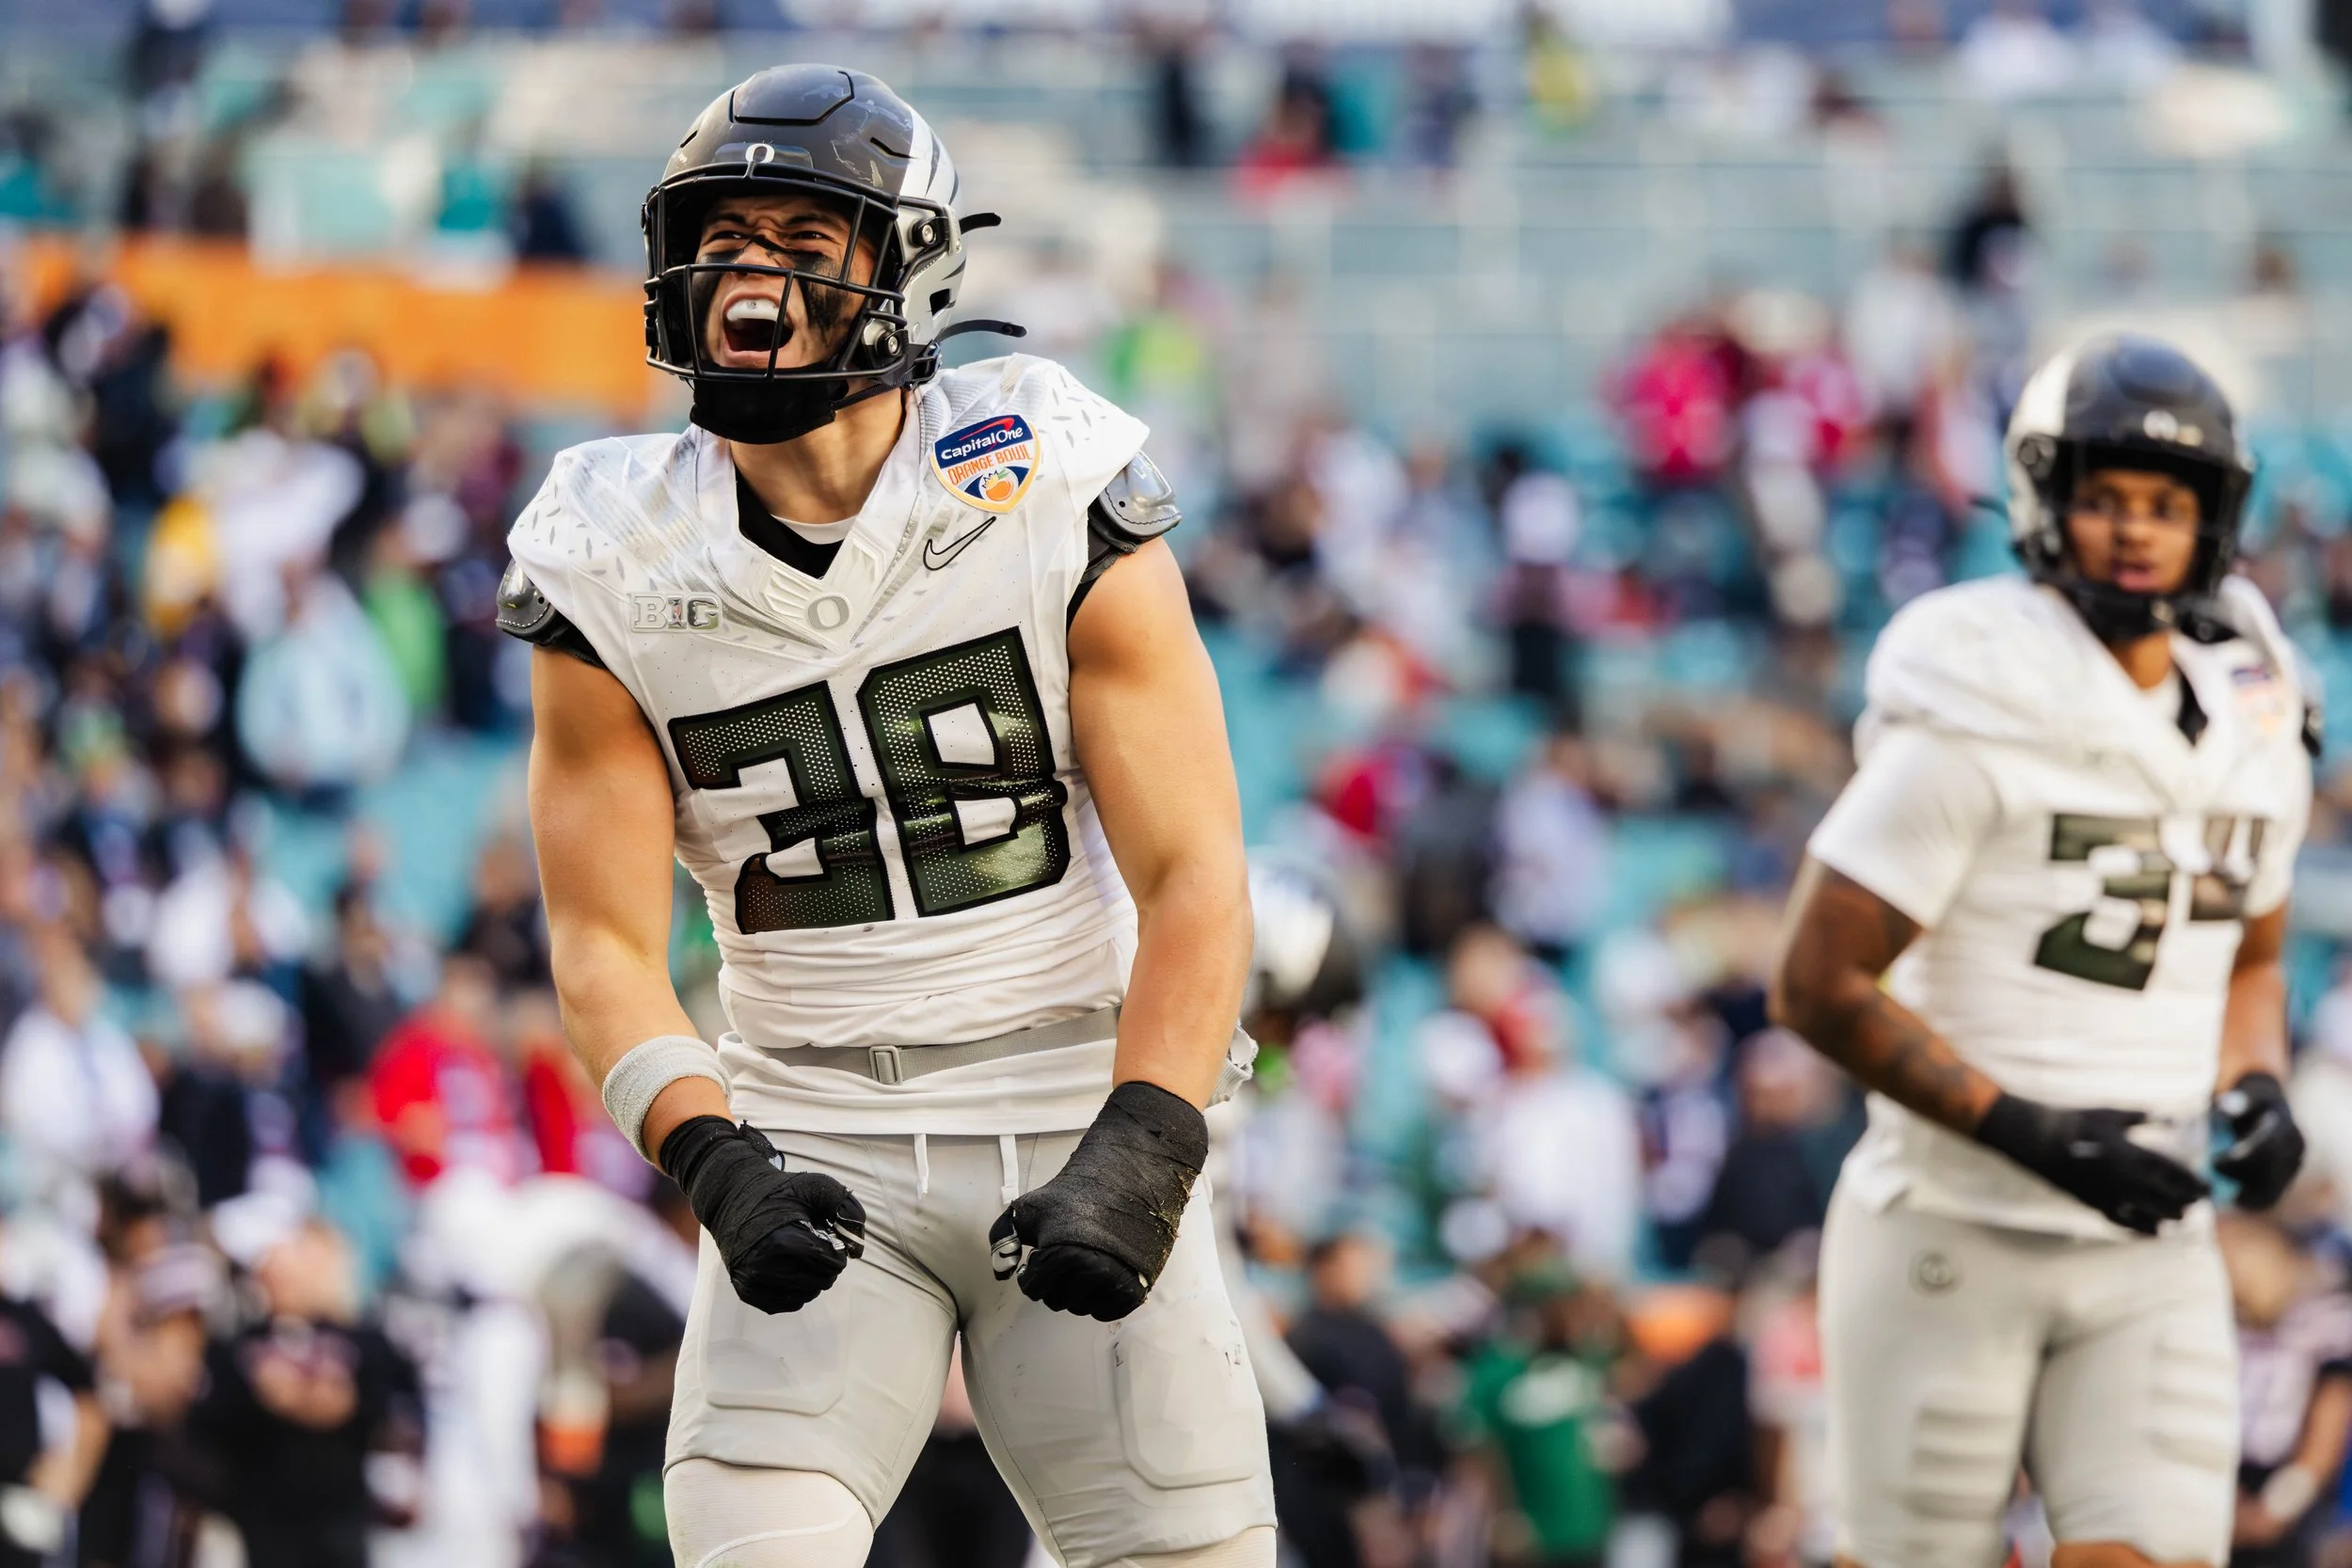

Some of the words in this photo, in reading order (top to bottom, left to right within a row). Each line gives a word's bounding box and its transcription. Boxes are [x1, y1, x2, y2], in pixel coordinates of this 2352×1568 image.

[947, 455, 994, 484] ORANGE
[996, 443, 1033, 466] BOWL
[667, 626, 1072, 935] 38
